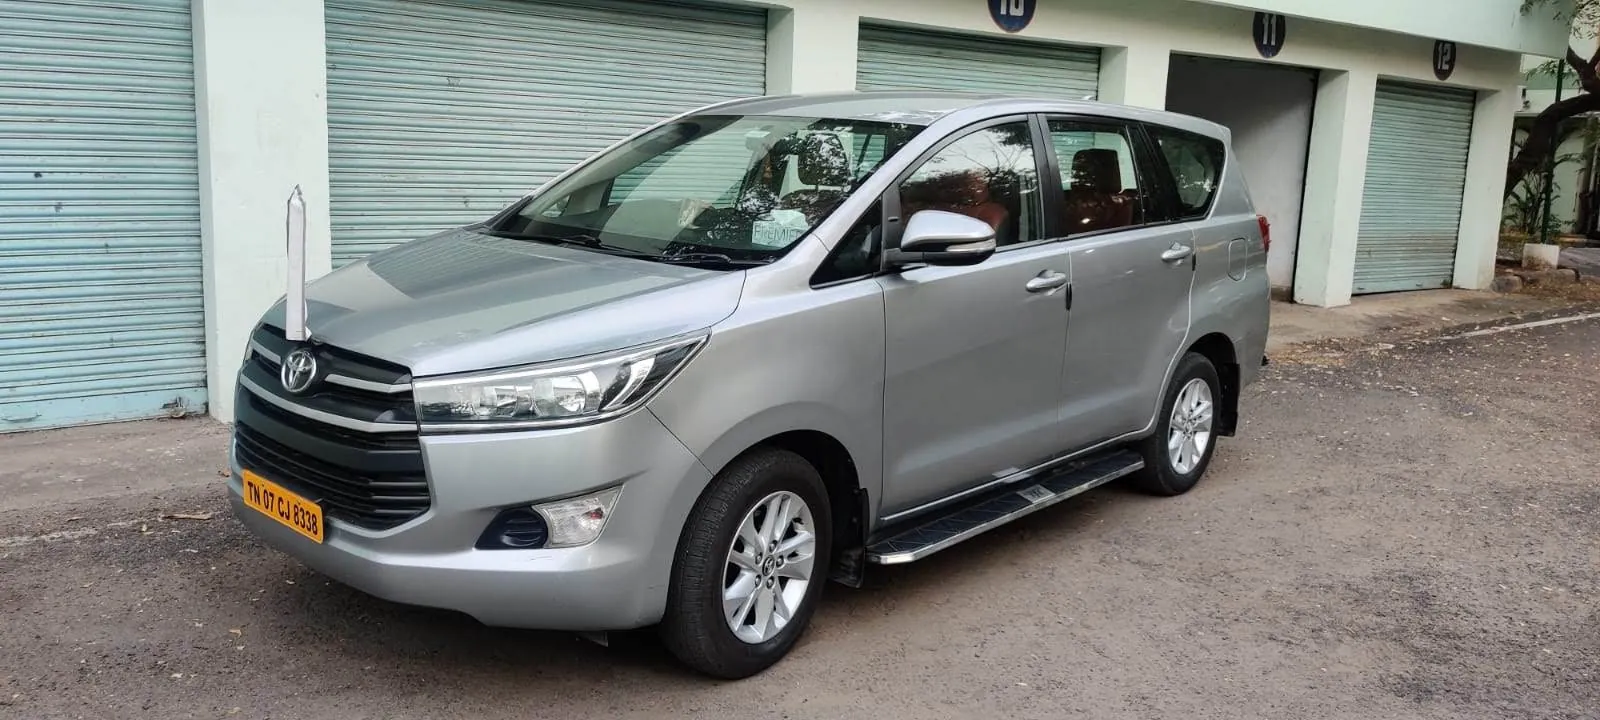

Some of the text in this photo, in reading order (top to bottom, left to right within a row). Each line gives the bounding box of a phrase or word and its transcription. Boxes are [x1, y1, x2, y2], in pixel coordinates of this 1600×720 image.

[1263, 13, 1277, 46] 11
[1438, 42, 1451, 70] 12
[247, 481, 318, 536] TN 07 CJ 8338
